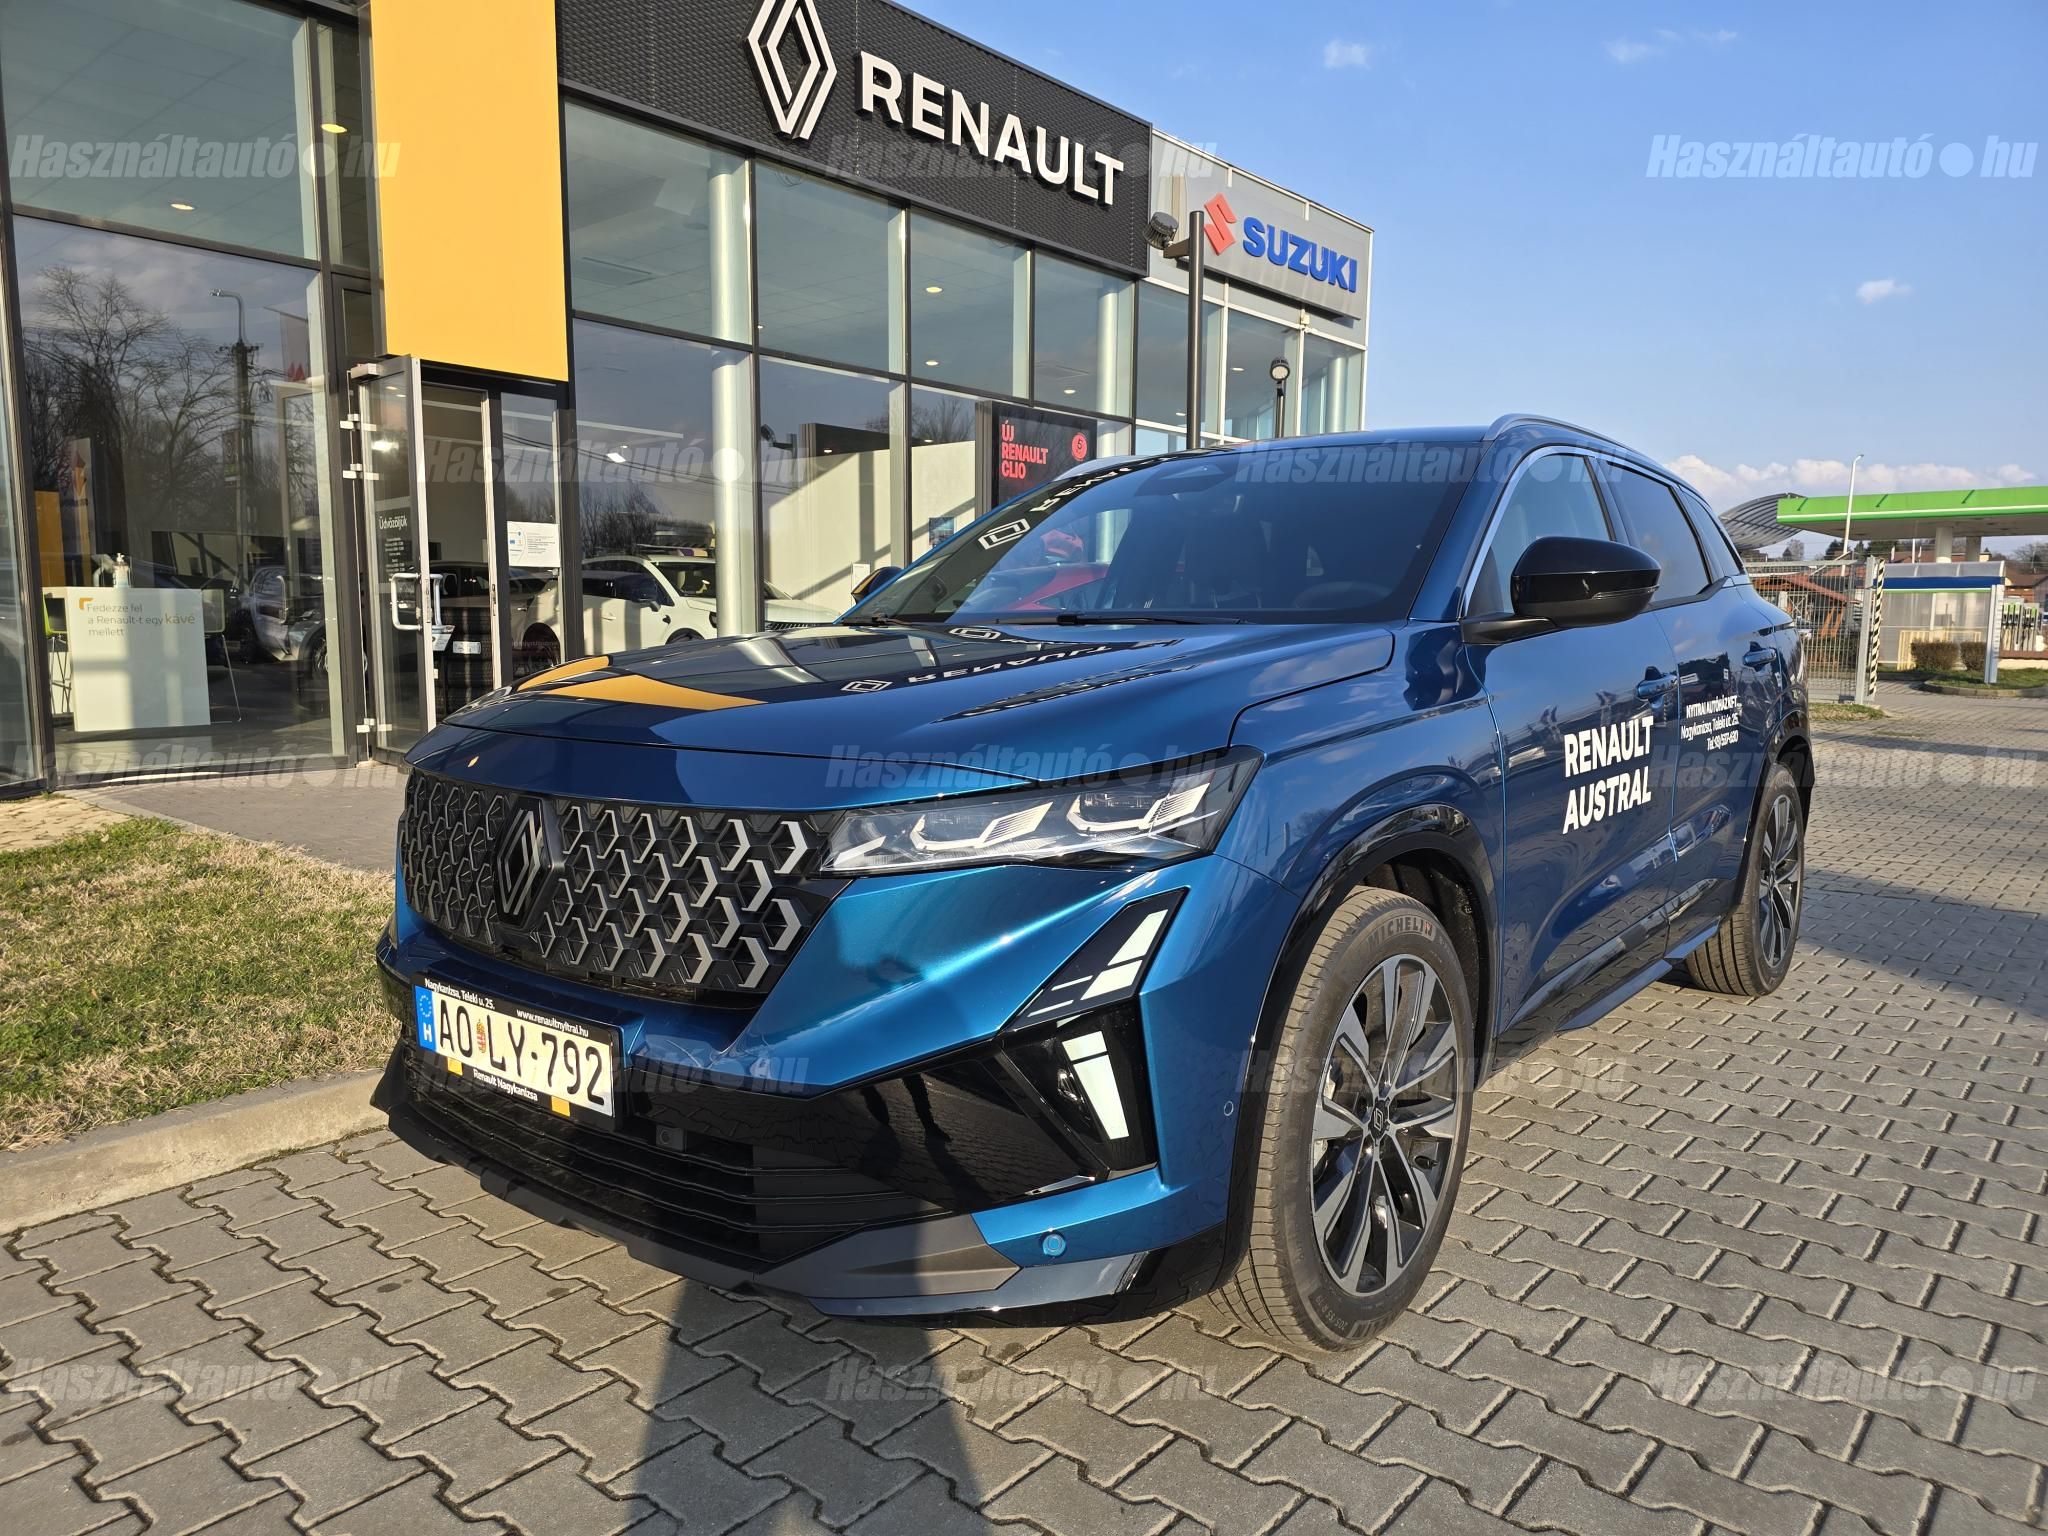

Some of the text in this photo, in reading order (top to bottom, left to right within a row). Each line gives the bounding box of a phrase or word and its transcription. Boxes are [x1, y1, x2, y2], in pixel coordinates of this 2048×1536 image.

[860, 50, 1124, 206] RENAULT
[1243, 216, 1358, 293] SUZUKI
[1001, 420, 1015, 442] ÚJ
[1001, 441, 1049, 465] RENAULT
[1001, 460, 1026, 479] CLIO
[87, 603, 143, 613] Fedezze fel
[87, 613, 196, 627] a Renault-t egy kávé
[88, 628, 125, 637] mellett
[1564, 715, 1654, 778] RENAULT
[1562, 765, 1652, 835] AUSTRAL
[1367, 915, 1434, 953] MICHELIN
[422, 1022, 433, 1043] H
